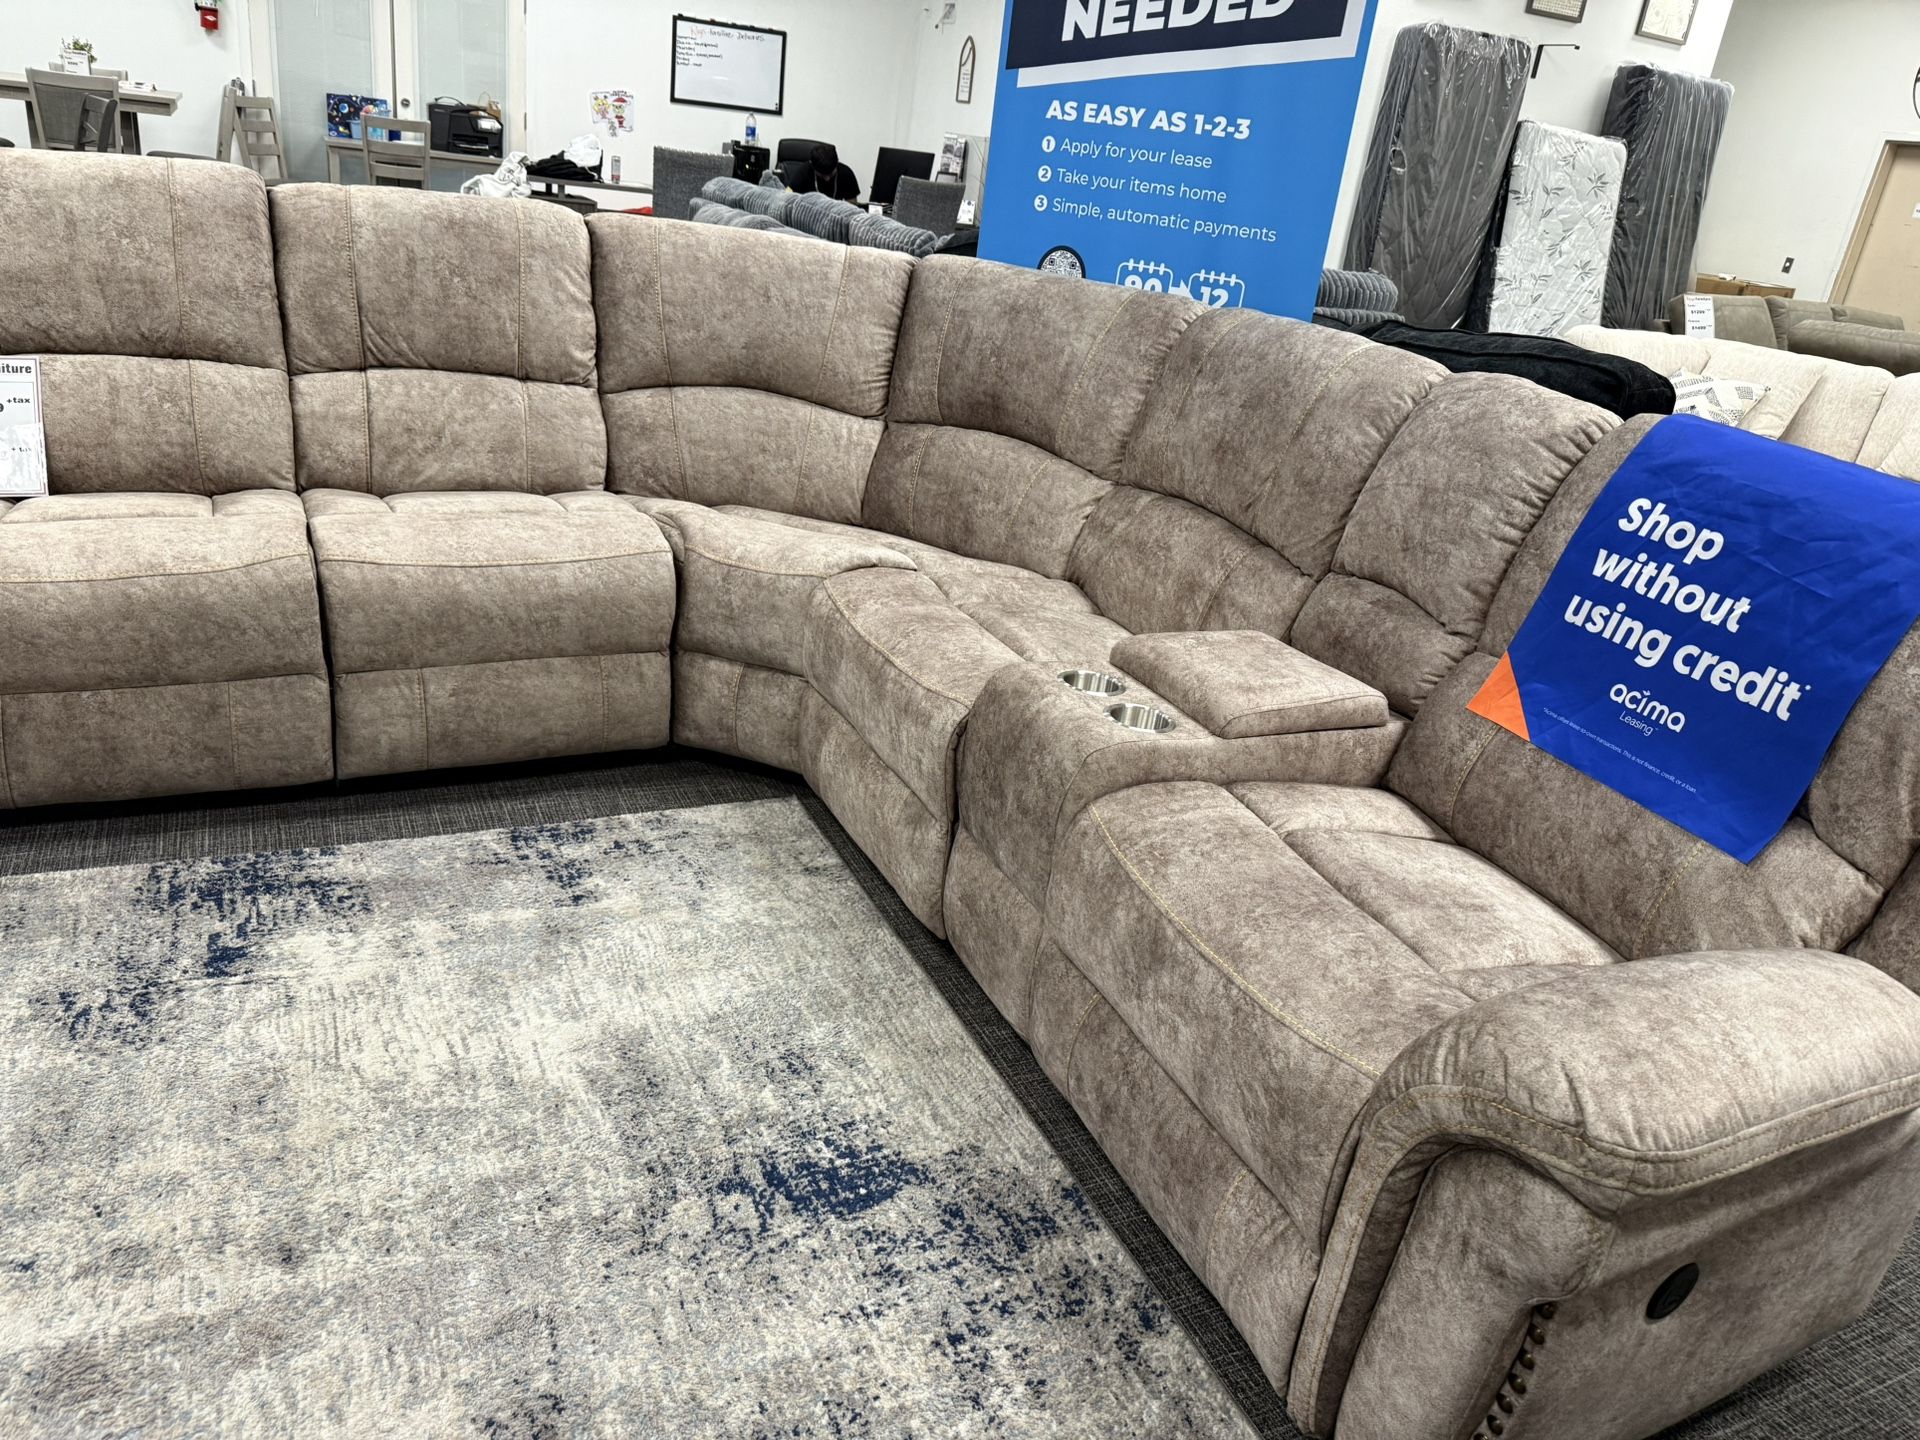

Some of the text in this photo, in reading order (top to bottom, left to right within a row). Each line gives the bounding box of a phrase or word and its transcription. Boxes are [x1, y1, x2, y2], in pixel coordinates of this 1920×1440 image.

[1061, 0, 1294, 41] NEEDED
[1045, 100, 1251, 140] AS EASY AS 1-2-3
[1060, 138, 1102, 158] Apply
[1105, 142, 1126, 158] for
[1128, 148, 1167, 163] your
[1170, 149, 1213, 169] lease
[1057, 168, 1088, 185] Take
[1091, 175, 1126, 190] your
[1129, 176, 1175, 197] items
[1179, 182, 1227, 203] home
[1052, 197, 1103, 221] Simple,
[1107, 208, 1190, 230] automatic
[1193, 219, 1277, 242] payments
[0, 363, 32, 374] iture
[1618, 498, 1724, 565] Shop
[1592, 548, 1751, 633] without
[1564, 595, 1673, 668] using
[1609, 683, 1686, 733] acima
